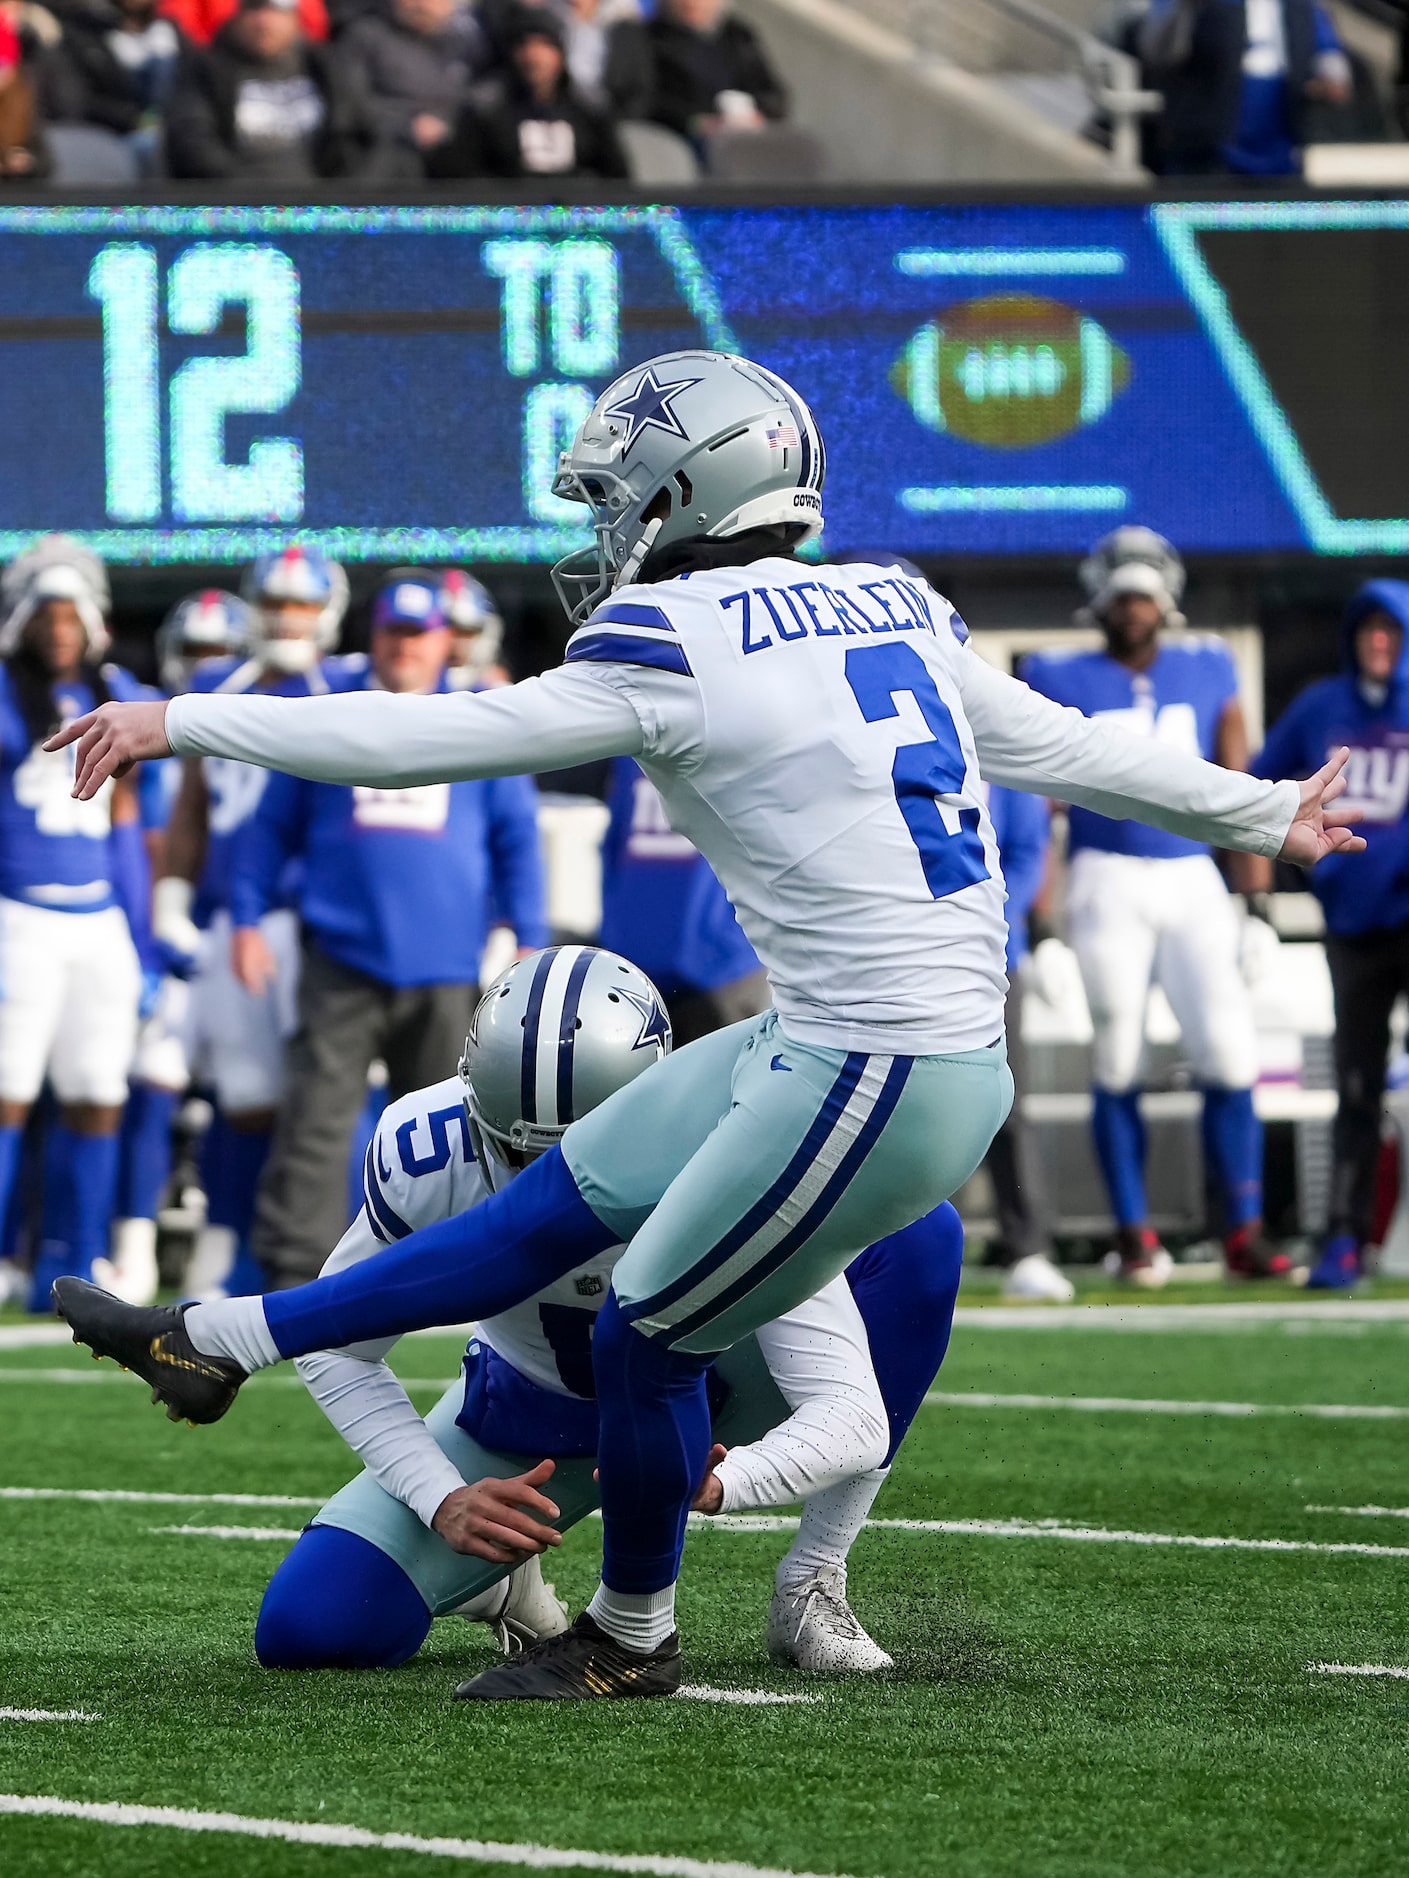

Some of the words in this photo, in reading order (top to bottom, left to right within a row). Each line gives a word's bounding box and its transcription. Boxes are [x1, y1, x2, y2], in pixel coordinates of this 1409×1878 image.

[479, 236, 620, 377] TO
[86, 240, 305, 523] 12
[718, 578, 937, 656] ZUERLEIN
[844, 640, 992, 900] 2
[395, 1103, 477, 1178] 5
